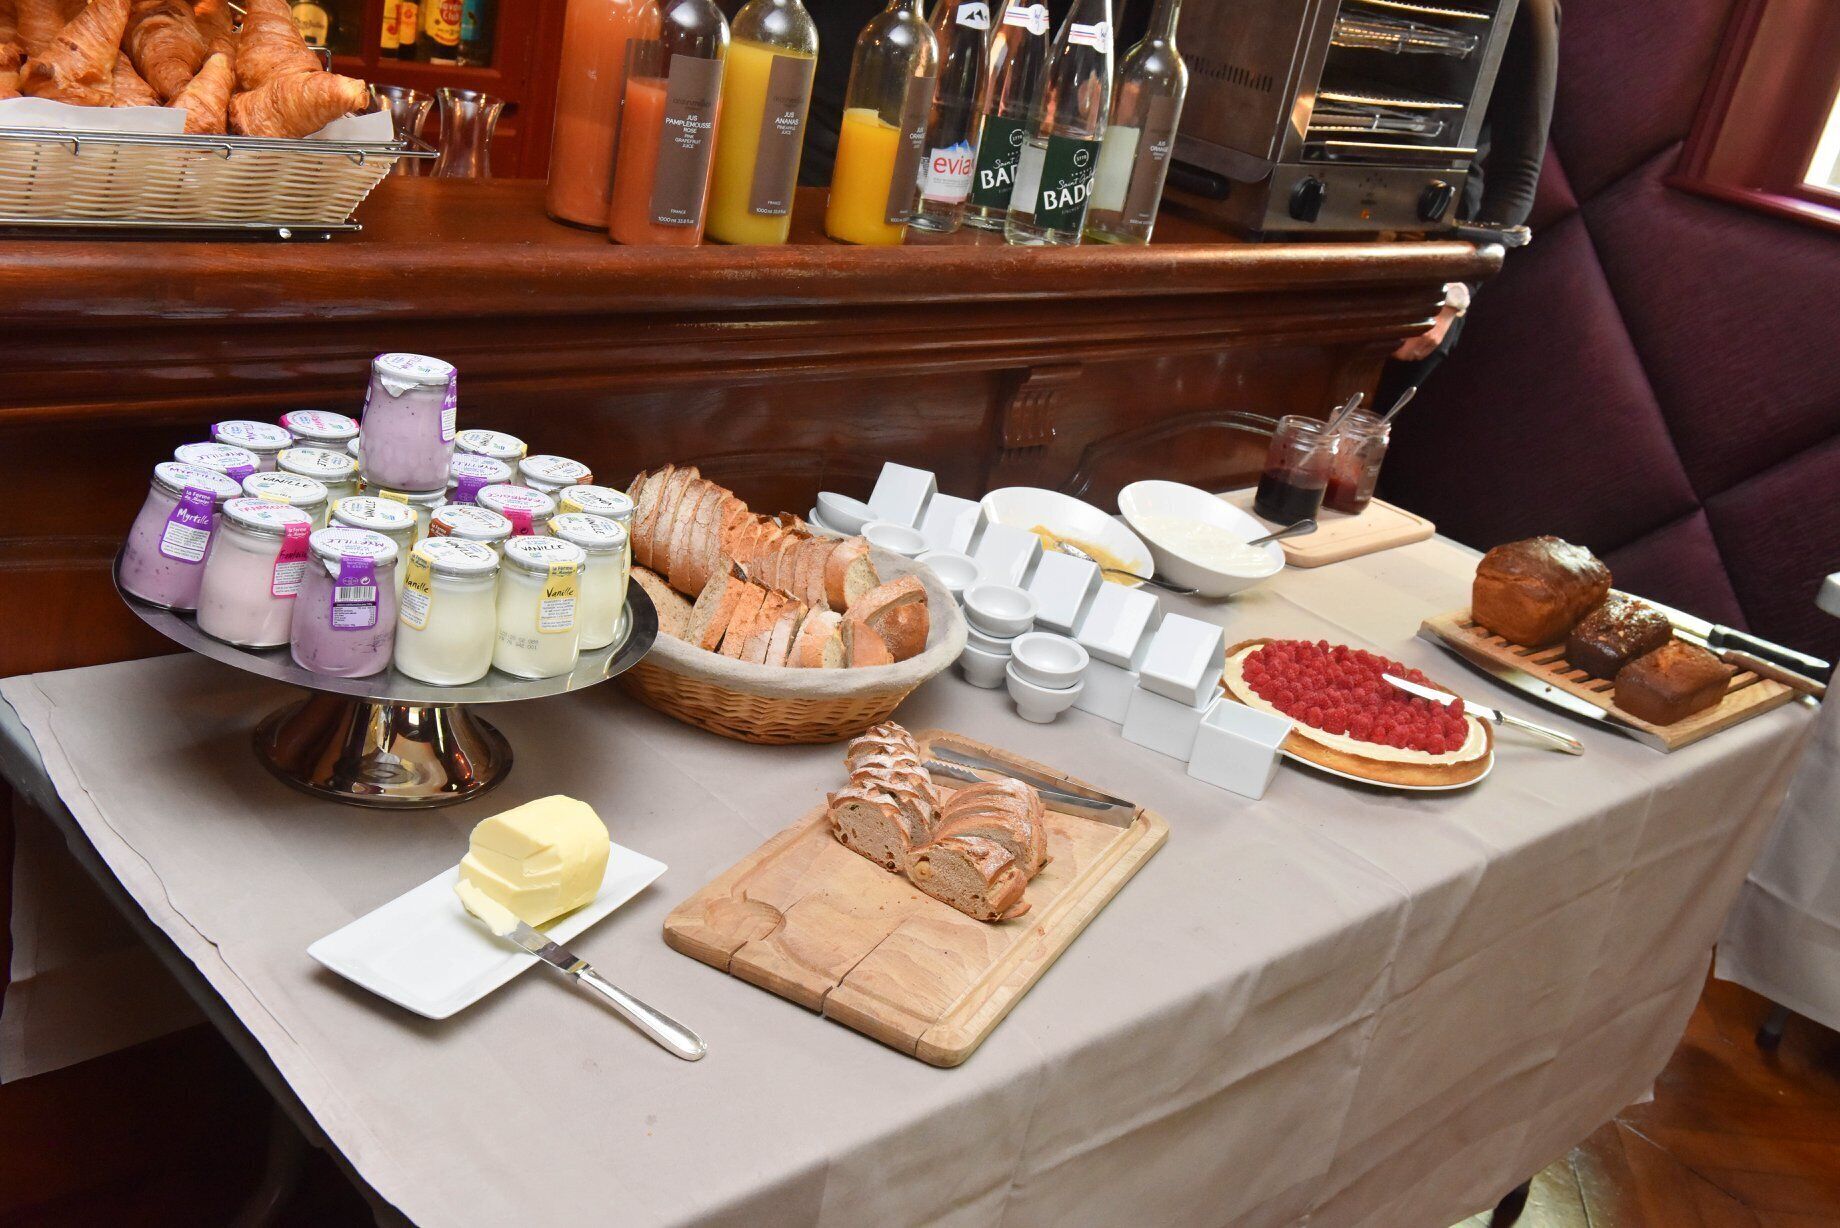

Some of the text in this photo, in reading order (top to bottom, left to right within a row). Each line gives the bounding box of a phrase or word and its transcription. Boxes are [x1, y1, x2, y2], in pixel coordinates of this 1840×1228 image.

[665, 117, 712, 129] PAMPLEMOUSSE
[775, 117, 799, 125] ANANAS
[262, 476, 312, 488] VANILLE
[546, 587, 574, 598] Vanille
